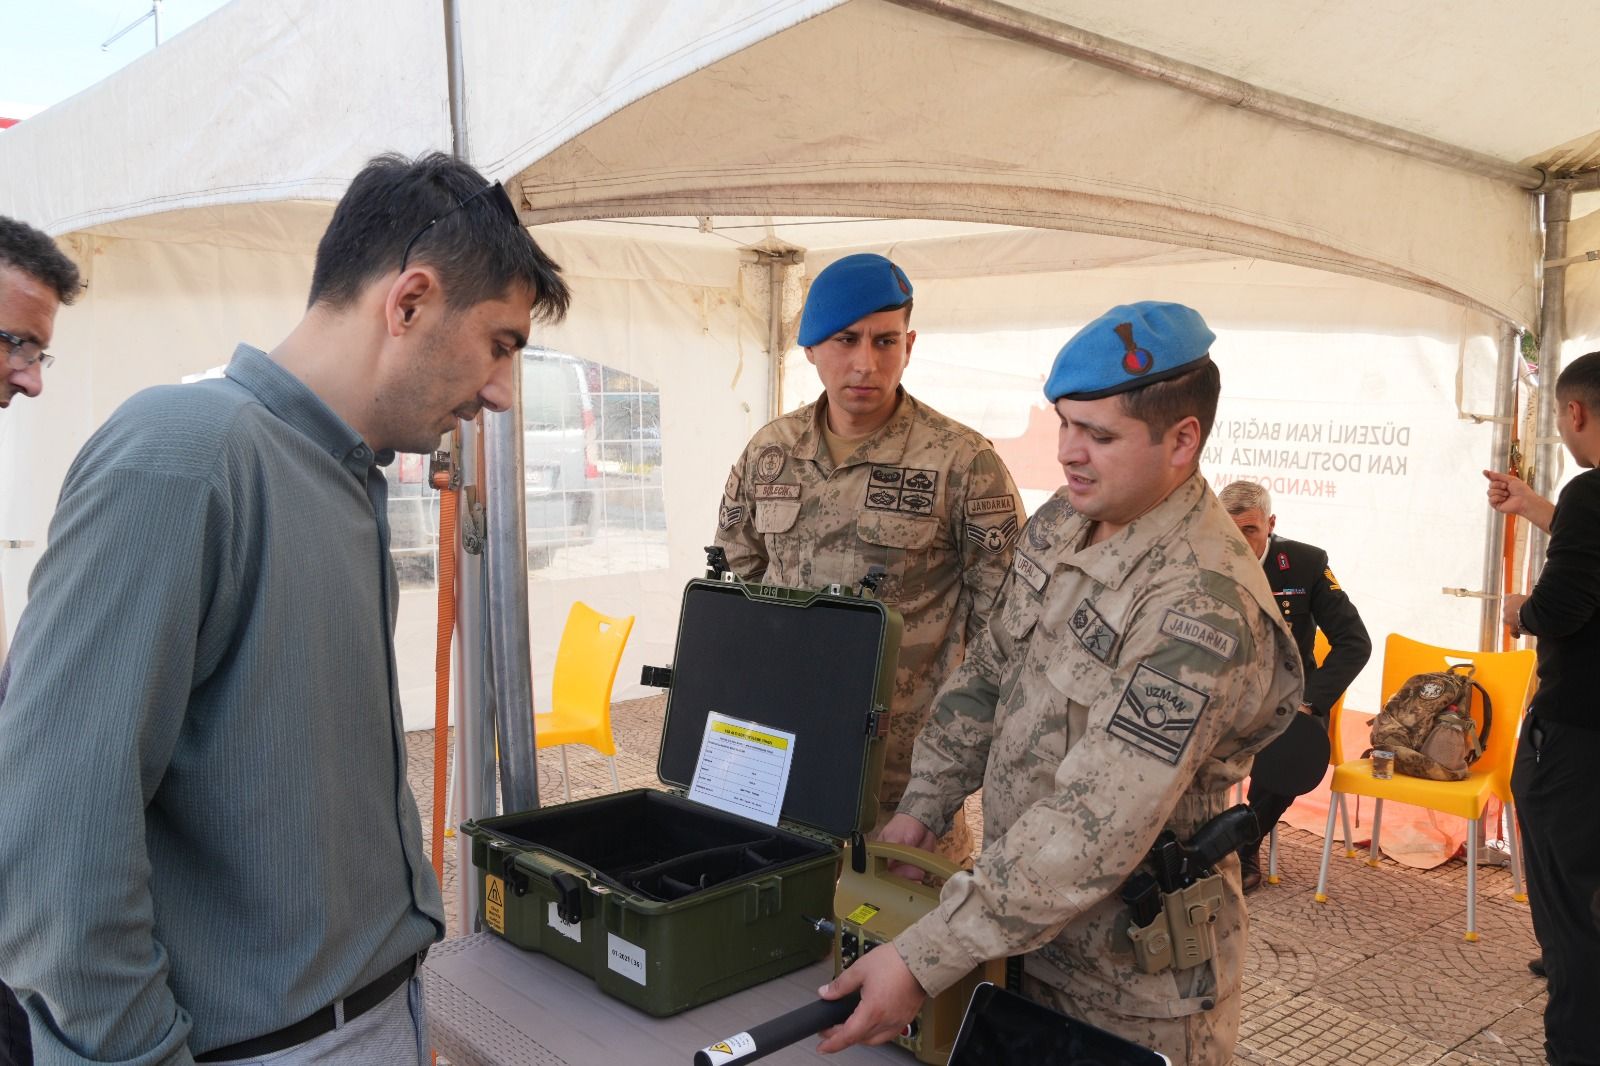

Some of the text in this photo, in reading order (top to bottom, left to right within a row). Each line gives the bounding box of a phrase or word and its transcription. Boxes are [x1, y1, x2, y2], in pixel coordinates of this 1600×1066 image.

[971, 498, 1011, 512] JANDARMA
[1169, 618, 1228, 653] JANDARMA
[1145, 686, 1187, 713] UZMAN
